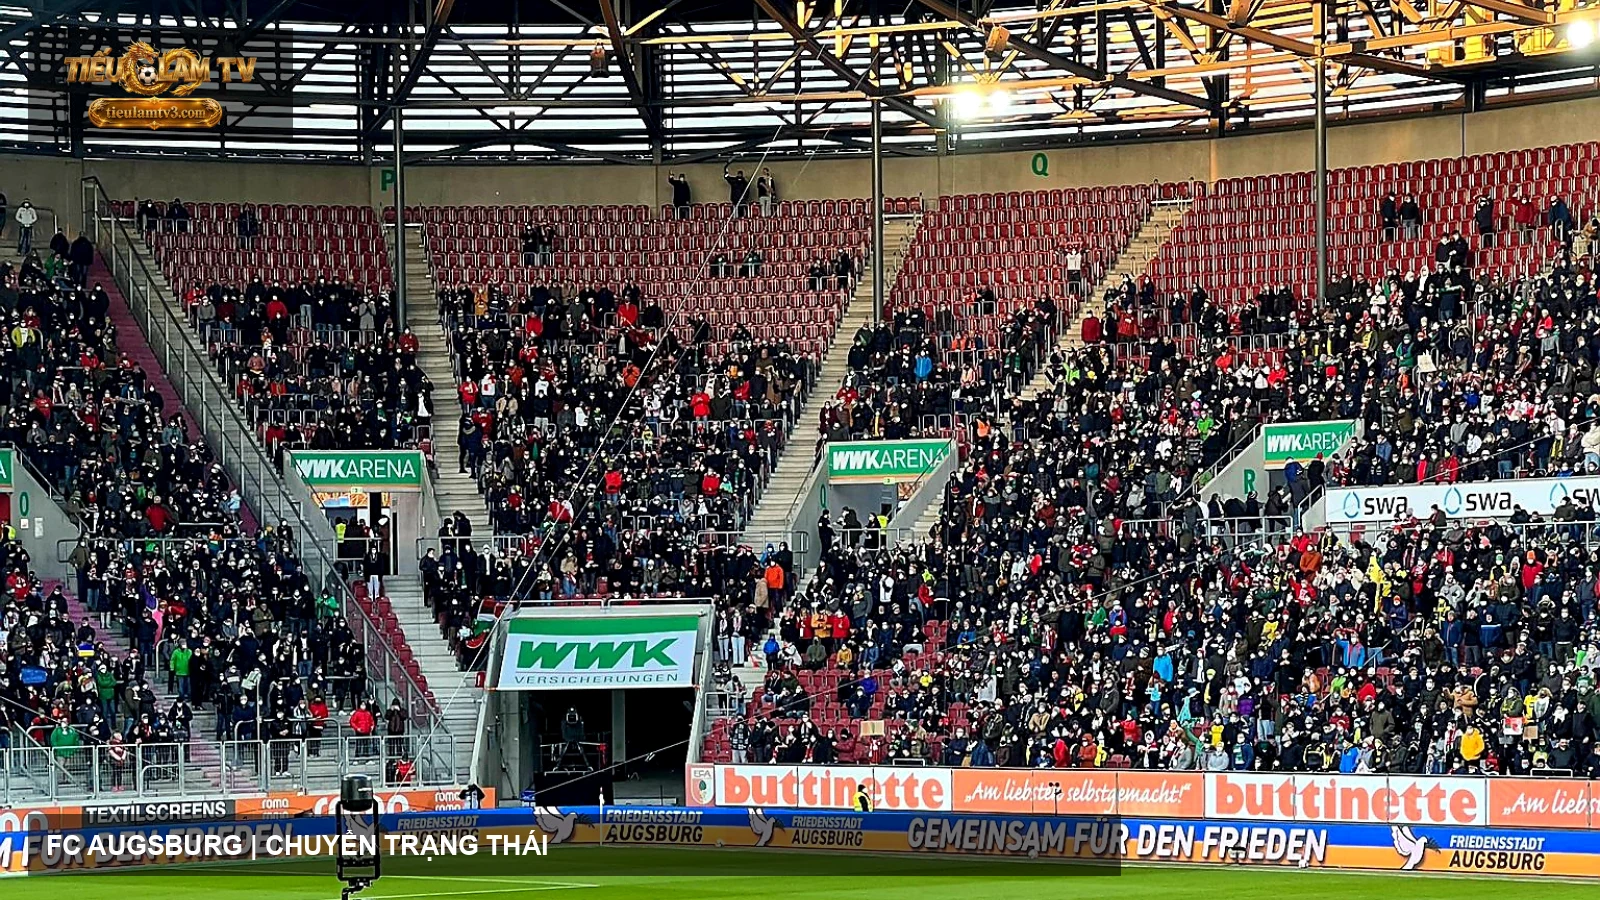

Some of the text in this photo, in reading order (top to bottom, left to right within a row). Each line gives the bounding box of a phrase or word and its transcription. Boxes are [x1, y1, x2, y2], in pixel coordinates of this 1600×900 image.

[1031, 152, 1049, 177] Q
[381, 169, 397, 191] P
[1243, 469, 1256, 494] R
[1364, 496, 1408, 515] swa
[1466, 491, 1512, 511] swa
[516, 637, 680, 669] WWK
[515, 673, 679, 685] VERSICHERUNGEN
[724, 768, 944, 809] buttinette
[1003, 778, 1063, 802] liebsten
[262, 798, 289, 809] roma
[1215, 775, 1478, 823] buttinette
[86, 801, 226, 824] TEXTILSCREENS
[397, 815, 479, 830] FRIEDENSSTADT
[606, 809, 703, 824] FRIEDENSSTADT
[791, 815, 863, 830] FRIEDENSSTADT
[605, 824, 703, 844] AUGSBURG
[791, 829, 863, 847] AUGSBURG
[908, 816, 1328, 862] GEMEINSAM FÜR DEN FRIEDEN
[1450, 834, 1546, 851] FRIEDENSSTADT
[1449, 852, 1546, 871] AUGSBURG
